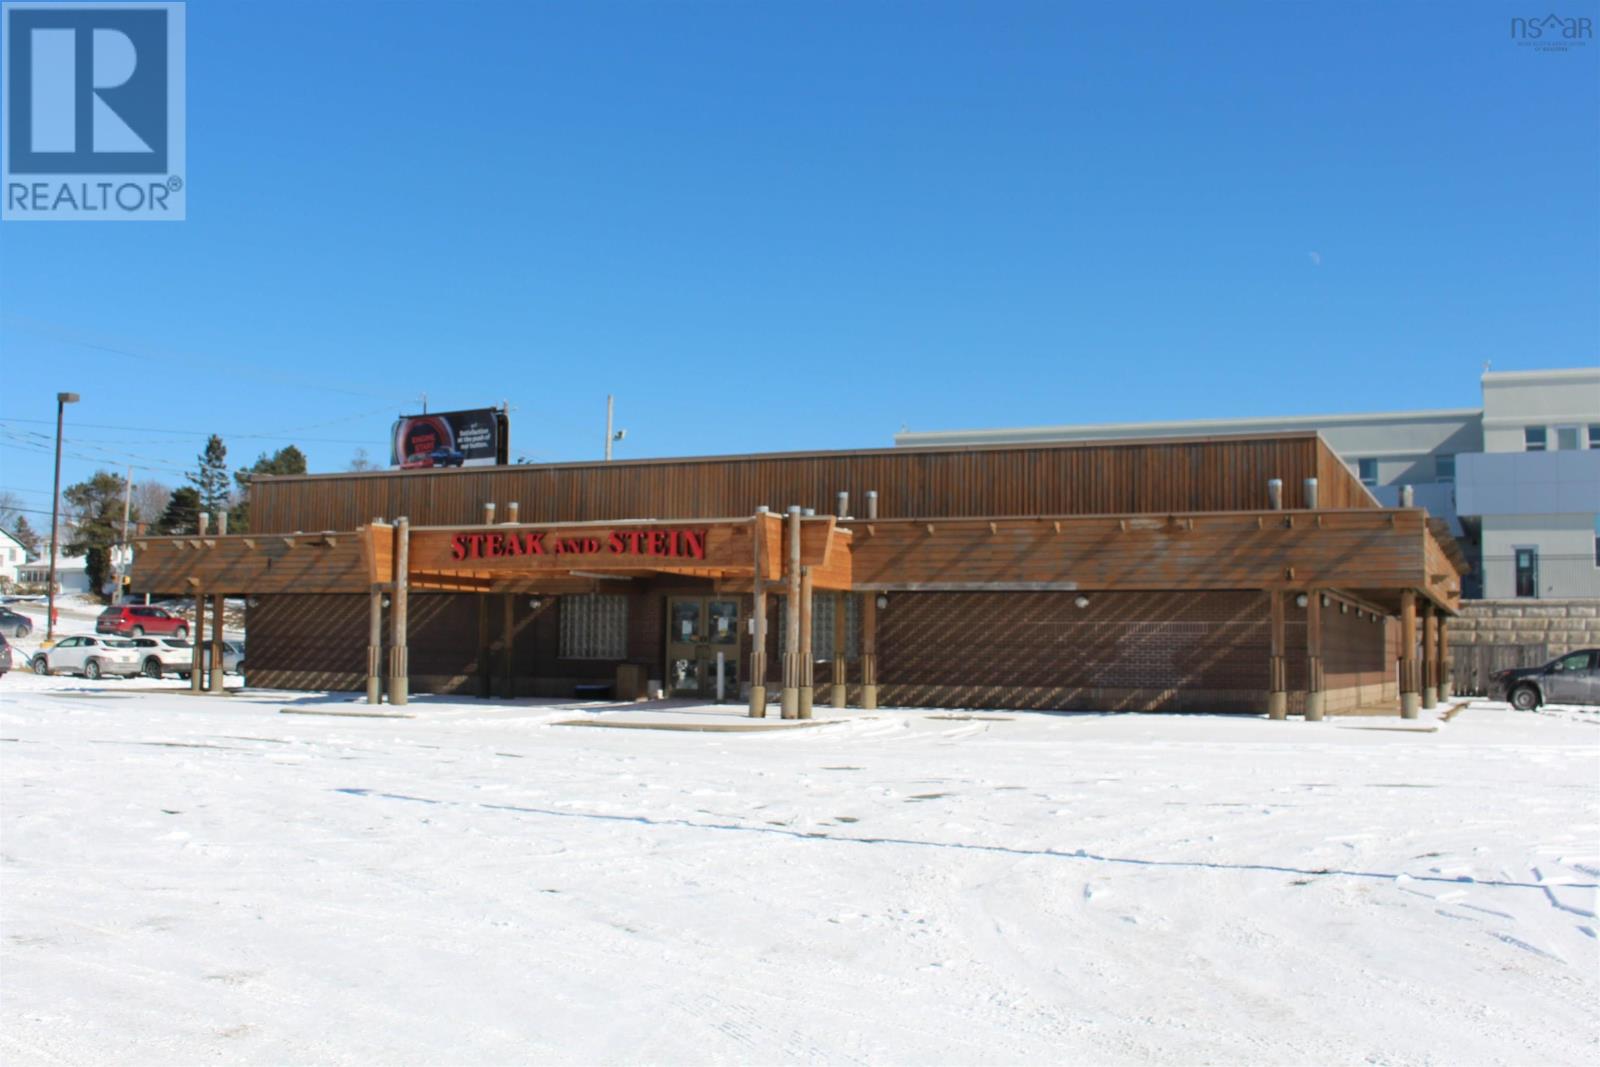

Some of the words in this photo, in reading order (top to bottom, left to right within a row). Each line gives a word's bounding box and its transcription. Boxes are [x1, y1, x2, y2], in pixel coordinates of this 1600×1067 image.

[451, 532, 546, 561] STEAK
[555, 537, 600, 555] AND
[608, 529, 708, 561] STEIN
